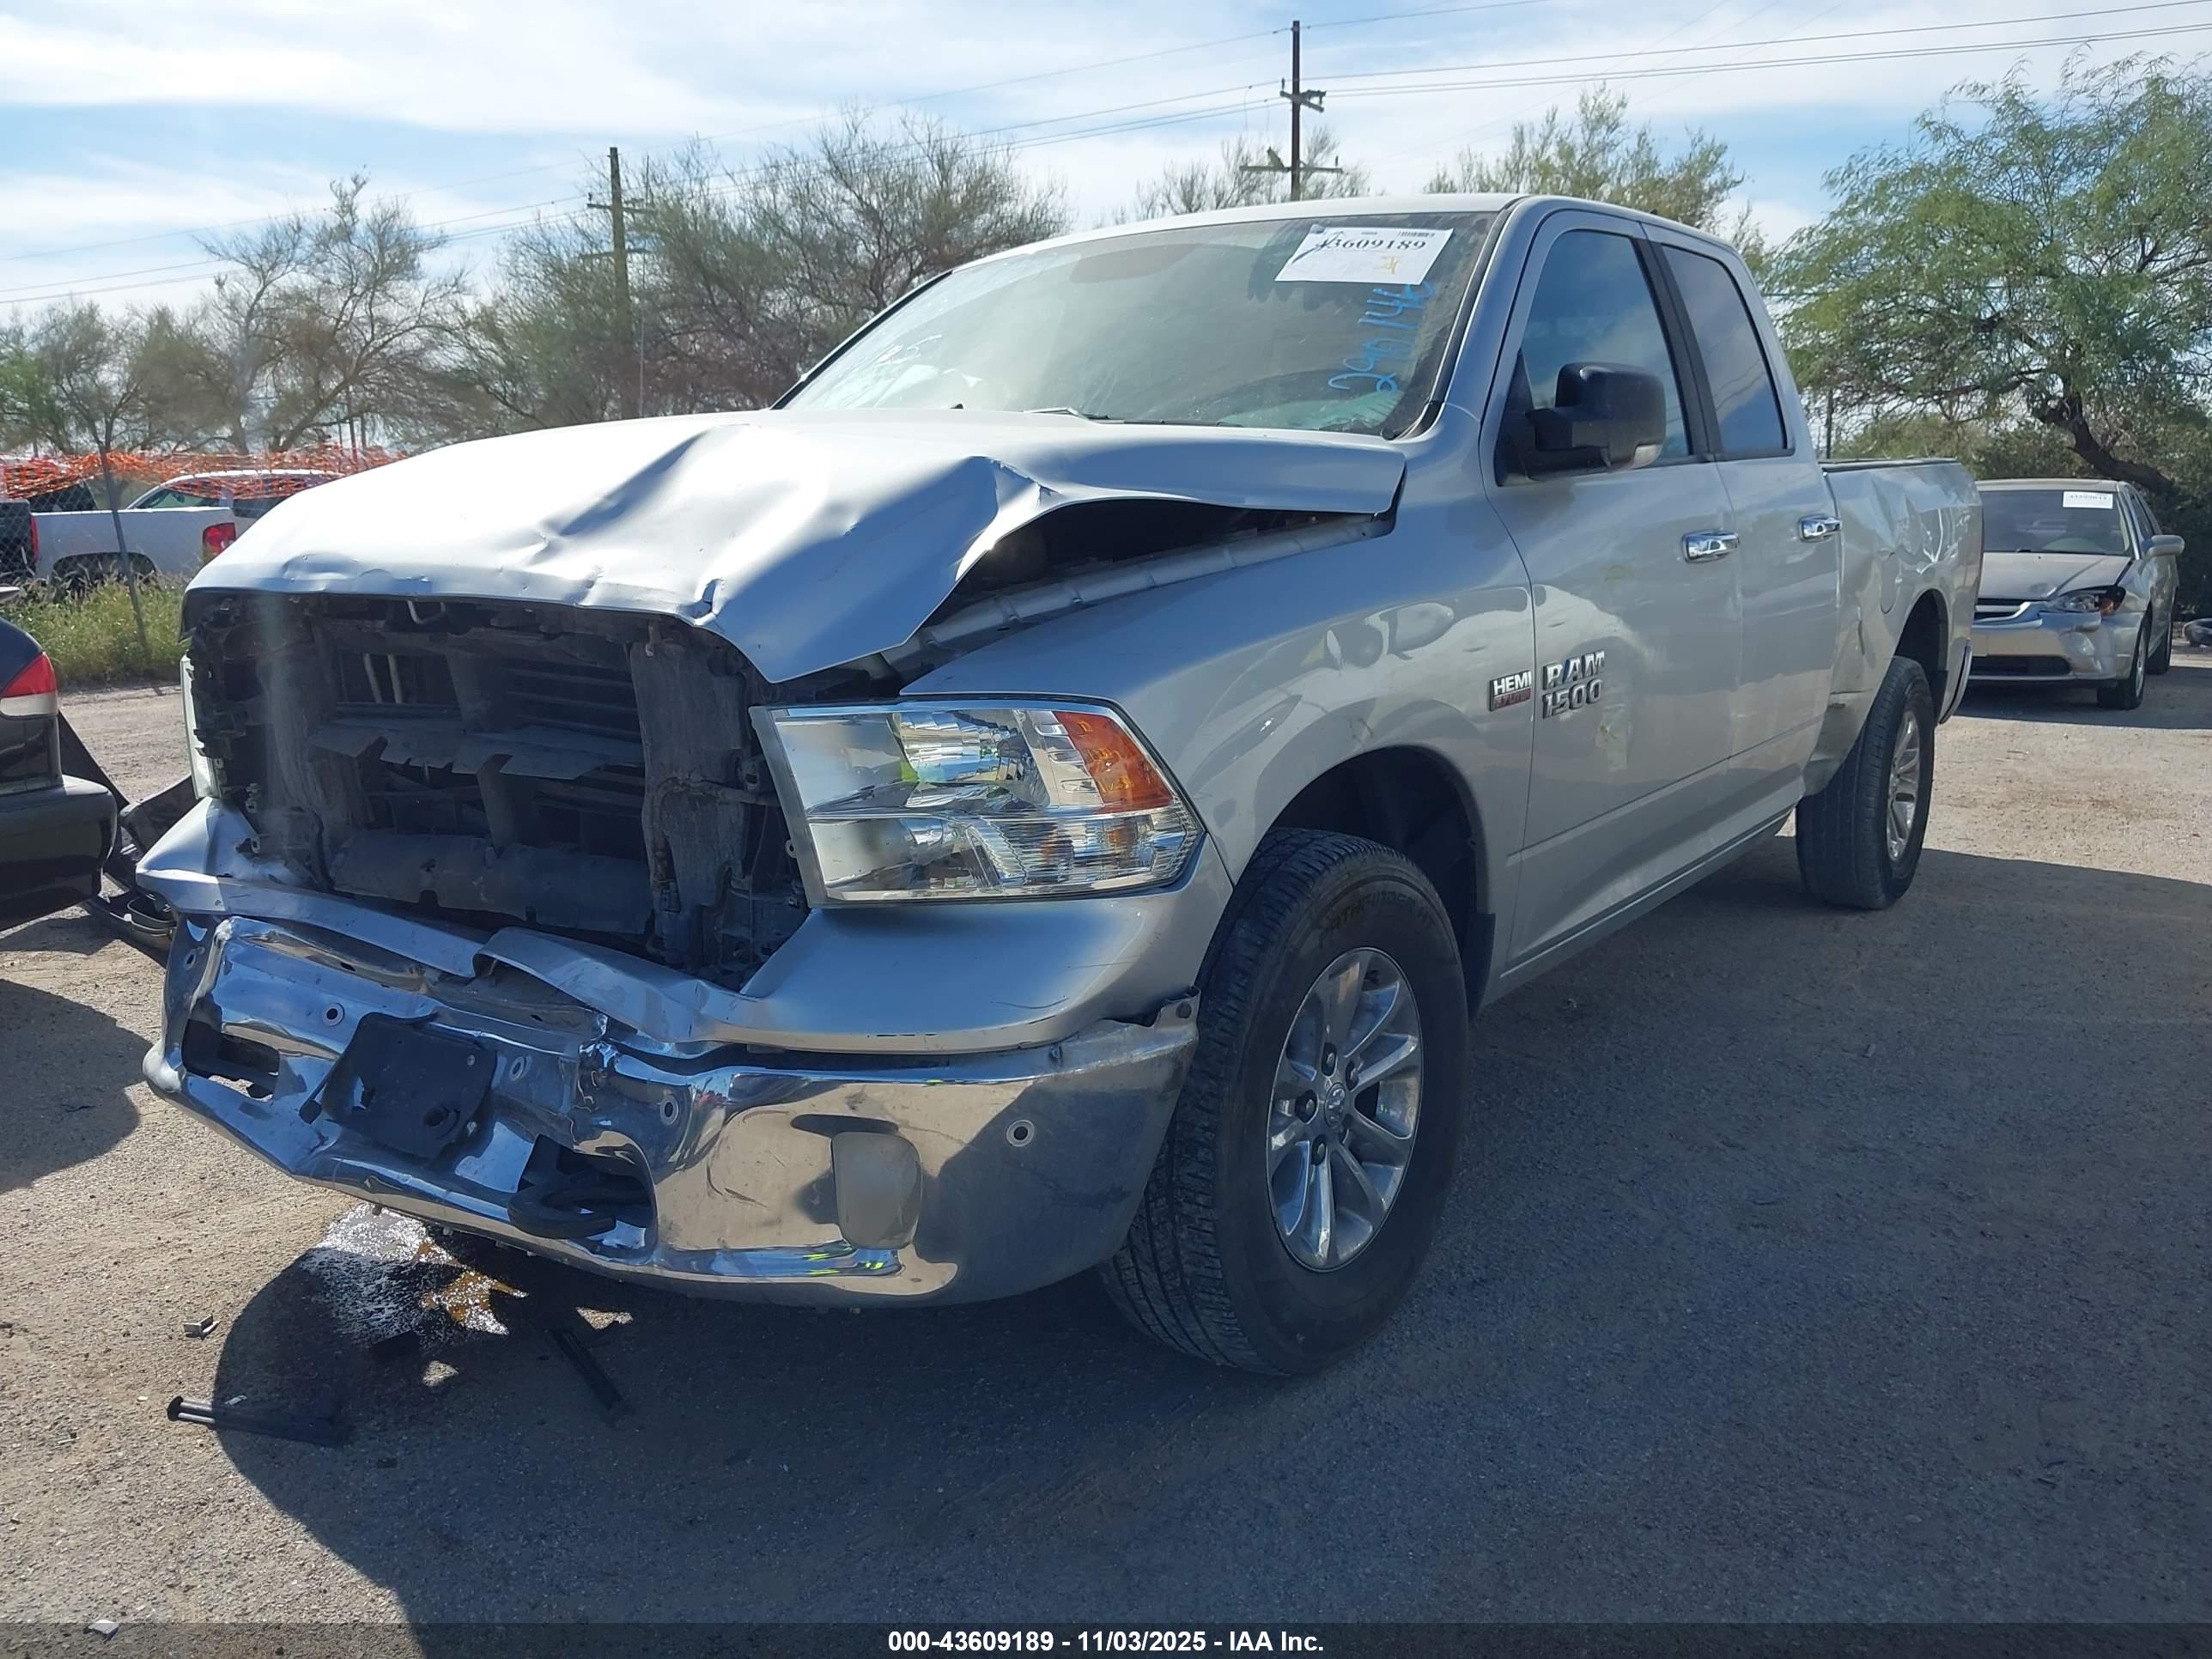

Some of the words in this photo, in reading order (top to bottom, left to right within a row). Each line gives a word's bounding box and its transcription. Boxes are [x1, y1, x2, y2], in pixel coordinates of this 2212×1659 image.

[1493, 671, 1532, 695] HEMI
[1543, 650, 1605, 690] RAM
[1543, 679, 1603, 718] 1500
